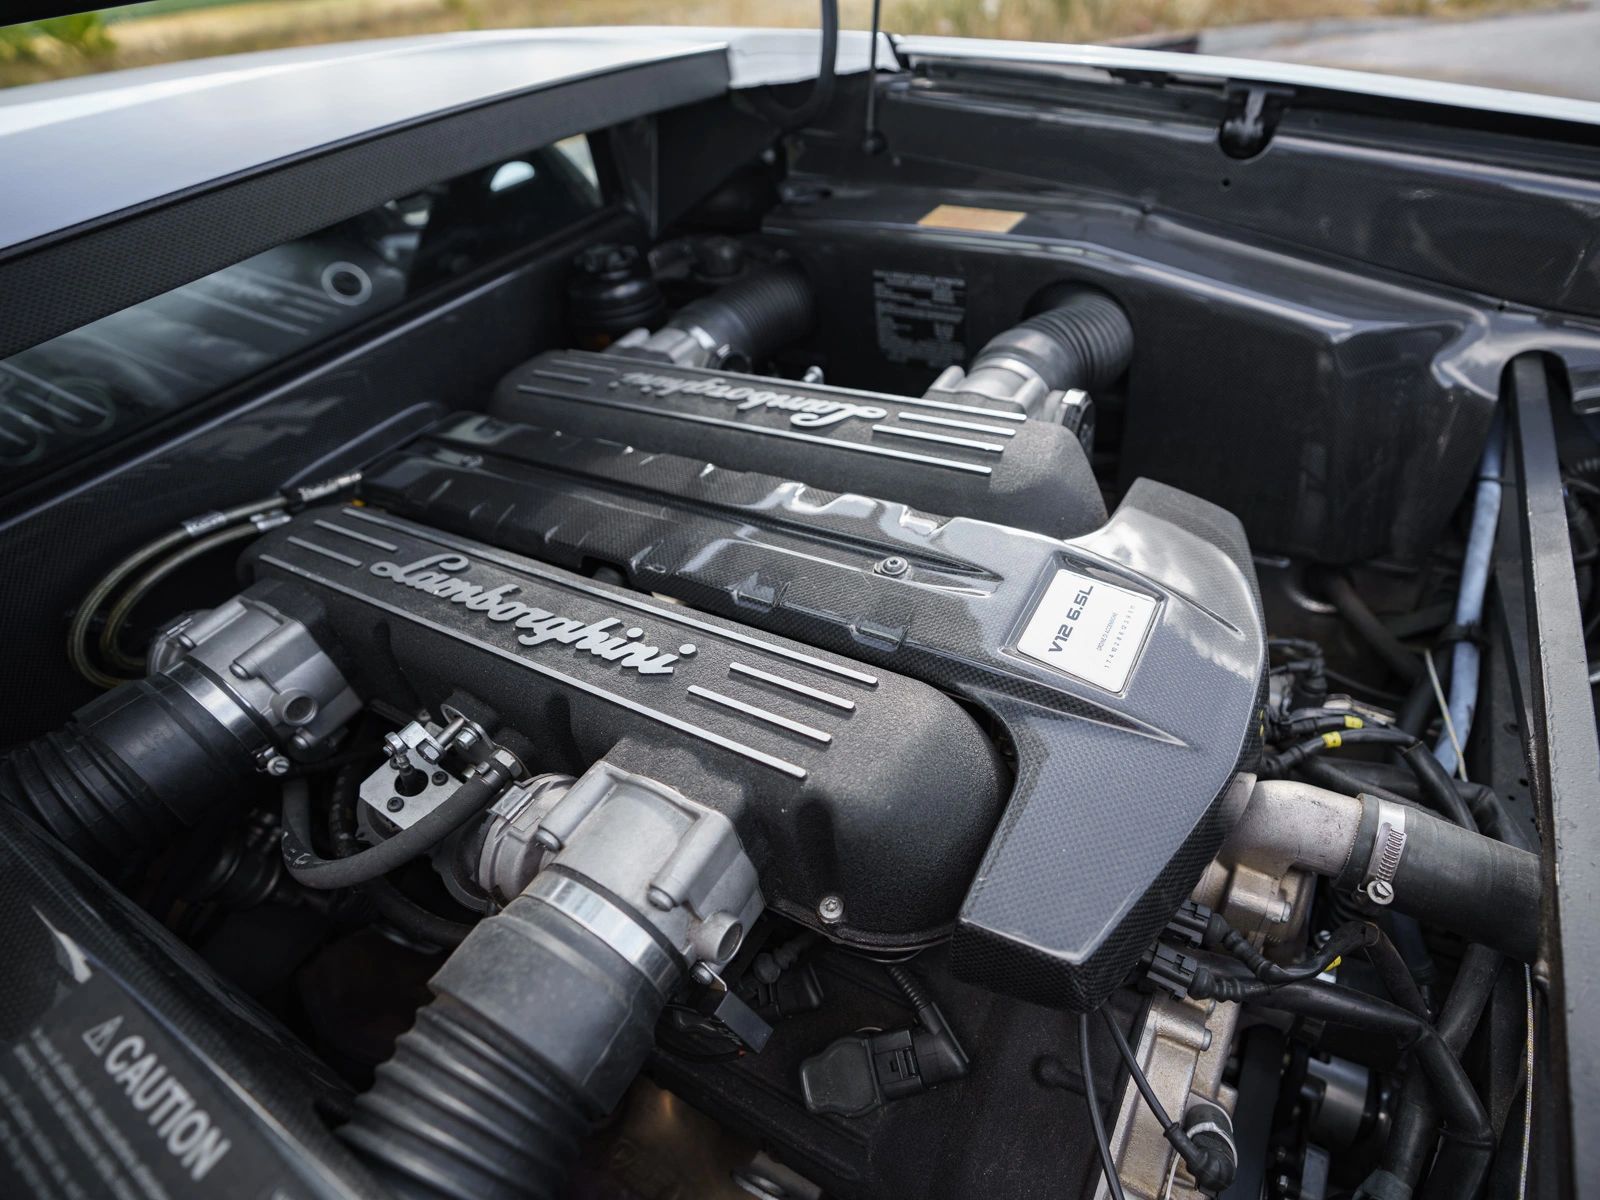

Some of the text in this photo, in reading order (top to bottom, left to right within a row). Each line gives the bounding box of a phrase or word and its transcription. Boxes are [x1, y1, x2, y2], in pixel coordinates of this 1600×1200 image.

[608, 371, 888, 428] Lamborghini
[369, 552, 697, 675] Lamborghini
[1048, 585, 1094, 652] V12 6.5L
[104, 1035, 232, 1182] CAUTION
